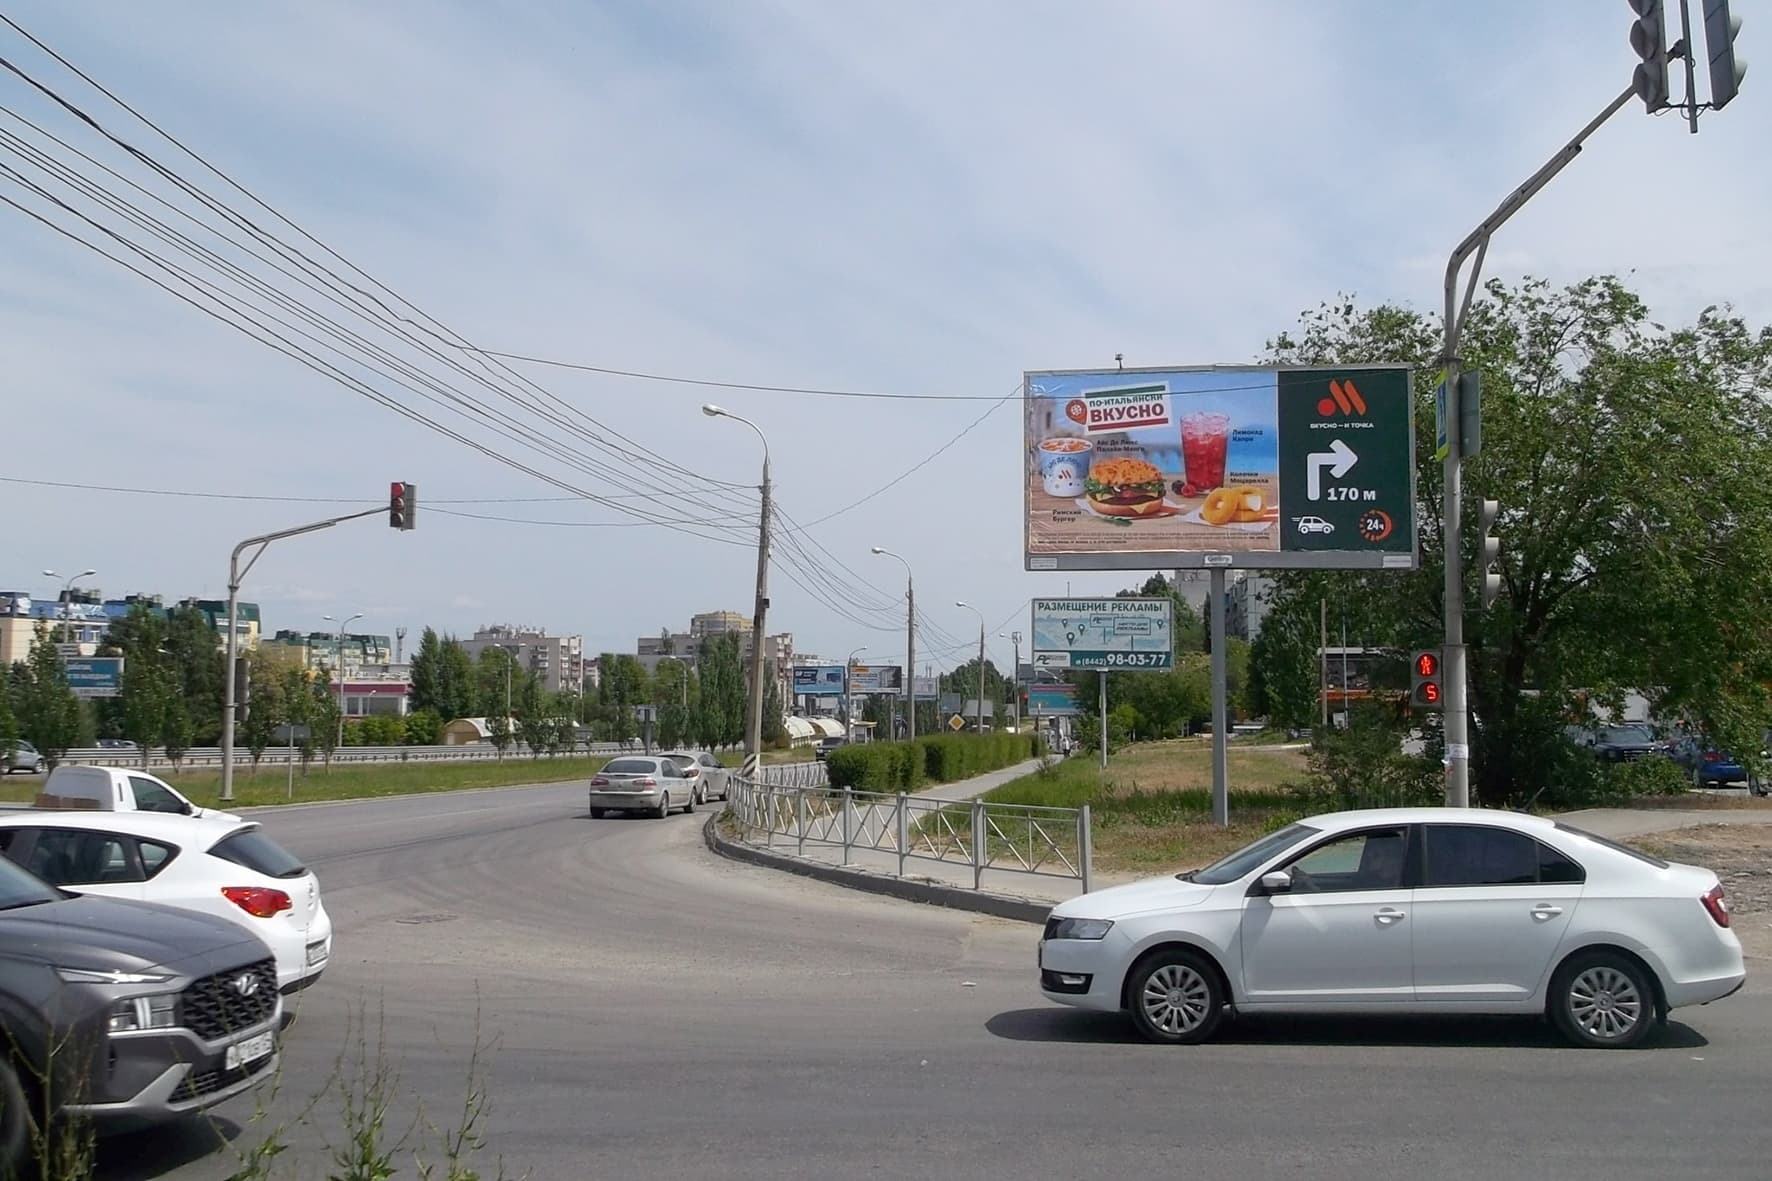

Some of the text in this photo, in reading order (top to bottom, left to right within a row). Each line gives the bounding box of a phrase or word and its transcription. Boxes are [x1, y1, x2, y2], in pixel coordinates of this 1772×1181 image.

[1089, 393, 1163, 407] ПО-ИТАЛЬЯНСКИ
[1090, 403, 1164, 422] ВКУСНО
[1327, 487, 1359, 501] 170
[1038, 602, 1162, 612] РАЗМЕЩЕНИЕ РЕКЛАМЫ
[1082, 654, 1166, 666] (8442) 98-03-77
